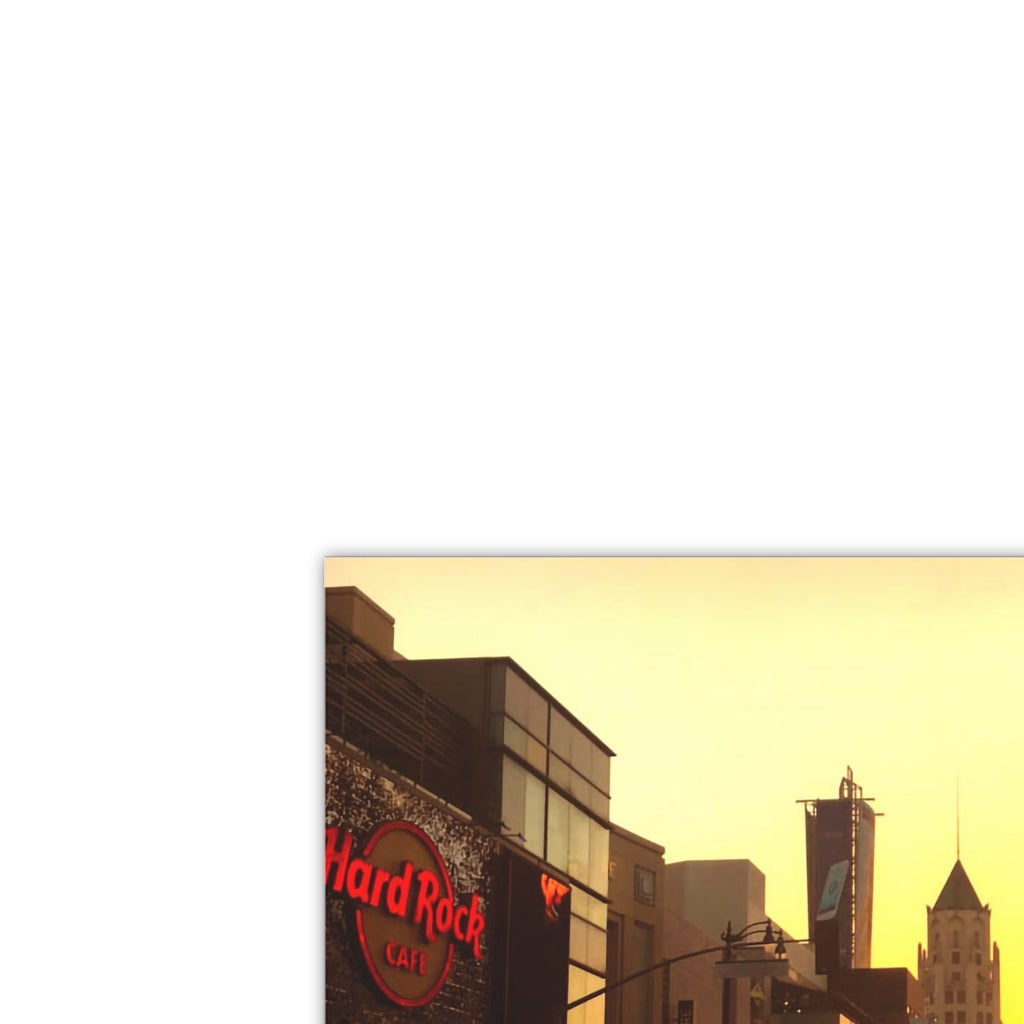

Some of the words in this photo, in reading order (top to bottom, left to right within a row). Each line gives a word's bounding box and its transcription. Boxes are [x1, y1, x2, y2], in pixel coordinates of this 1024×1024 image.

[325, 826, 414, 917] Hard
[414, 870, 485, 960] Rock
[386, 940, 429, 976] CAFE
